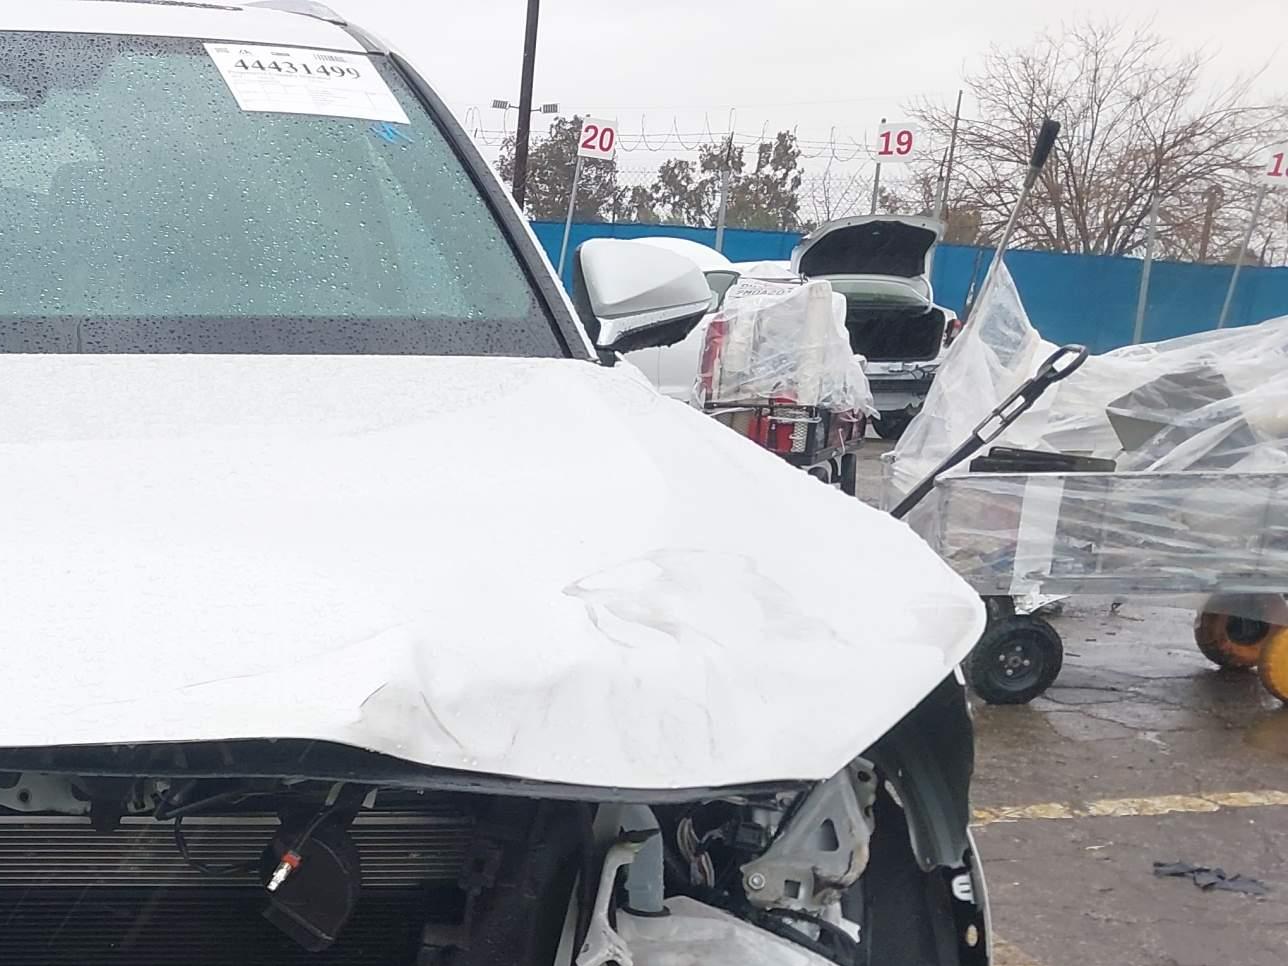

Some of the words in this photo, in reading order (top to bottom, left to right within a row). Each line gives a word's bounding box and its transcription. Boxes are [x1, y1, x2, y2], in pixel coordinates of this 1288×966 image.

[234, 58, 360, 79] 44431499
[581, 125, 614, 152] 20
[878, 130, 913, 155] 19
[1266, 151, 1288, 177] 1
